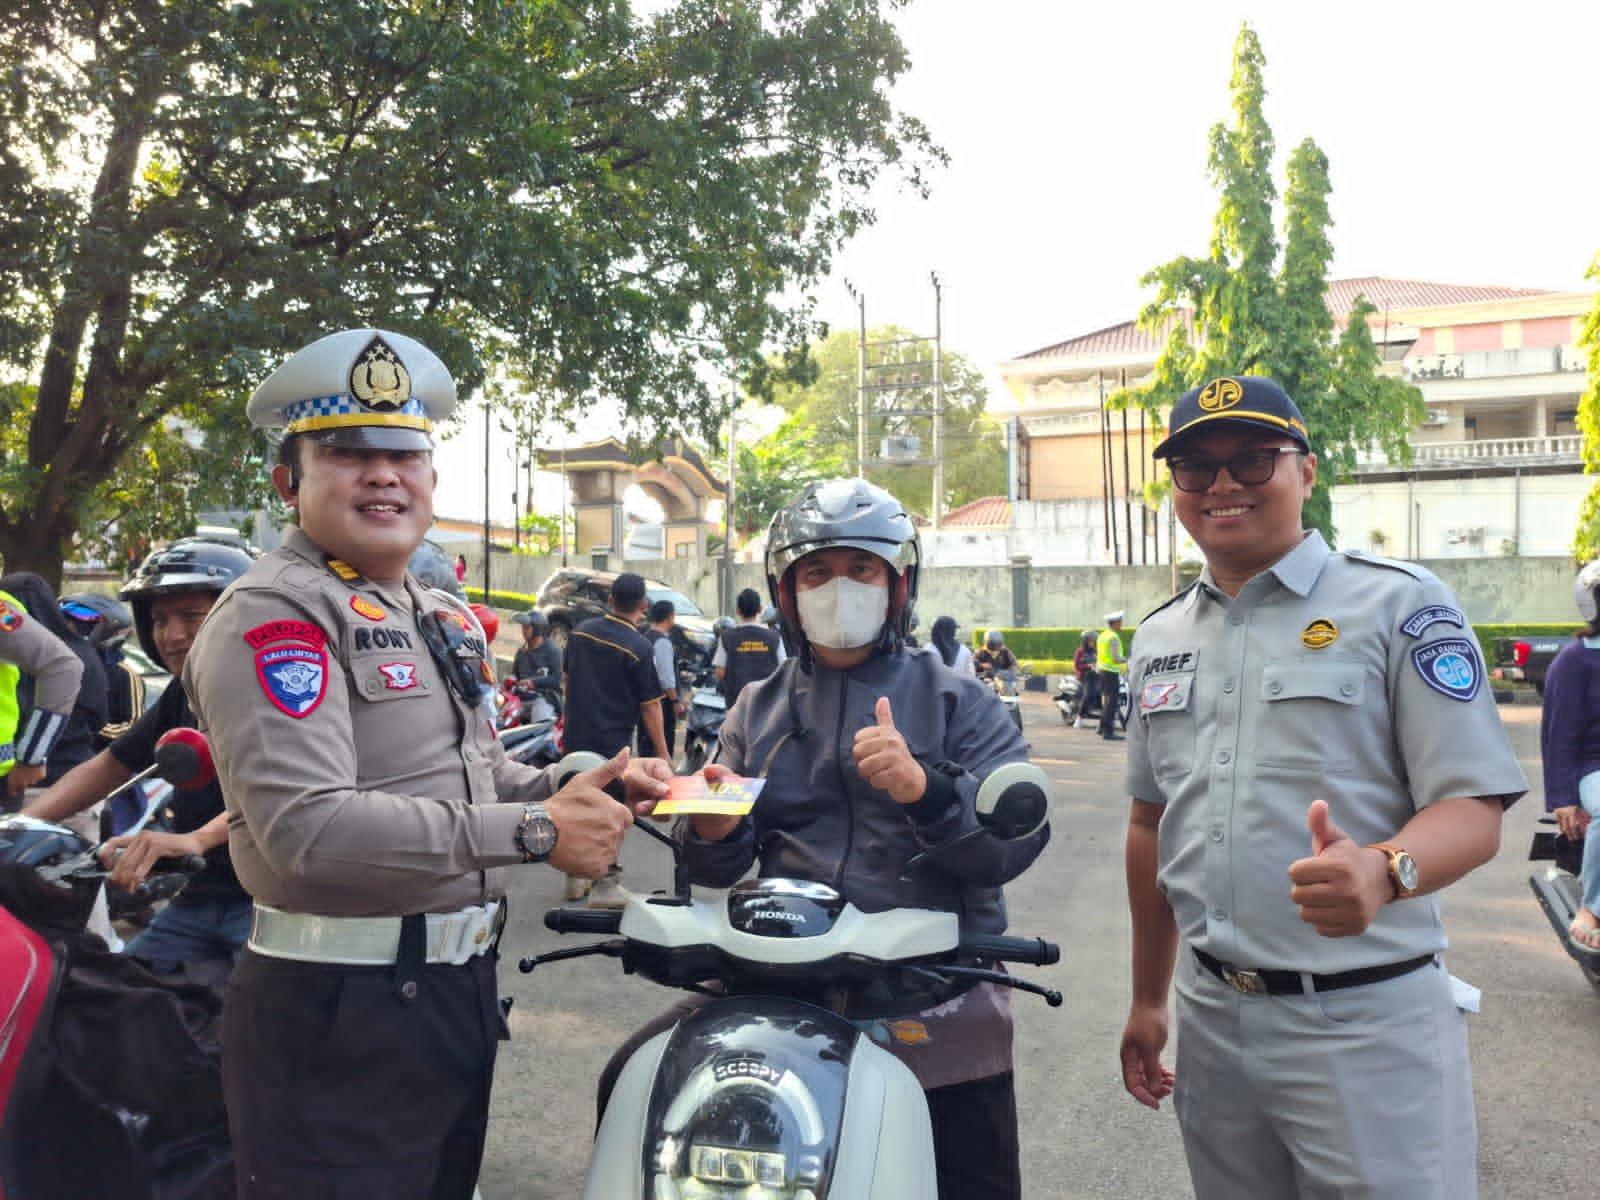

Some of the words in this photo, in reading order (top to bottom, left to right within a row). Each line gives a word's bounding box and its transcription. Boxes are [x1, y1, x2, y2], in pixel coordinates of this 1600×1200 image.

[355, 627, 413, 650] RONY
[754, 911, 807, 923] HONDA
[715, 1062, 780, 1081] SCOOPY
